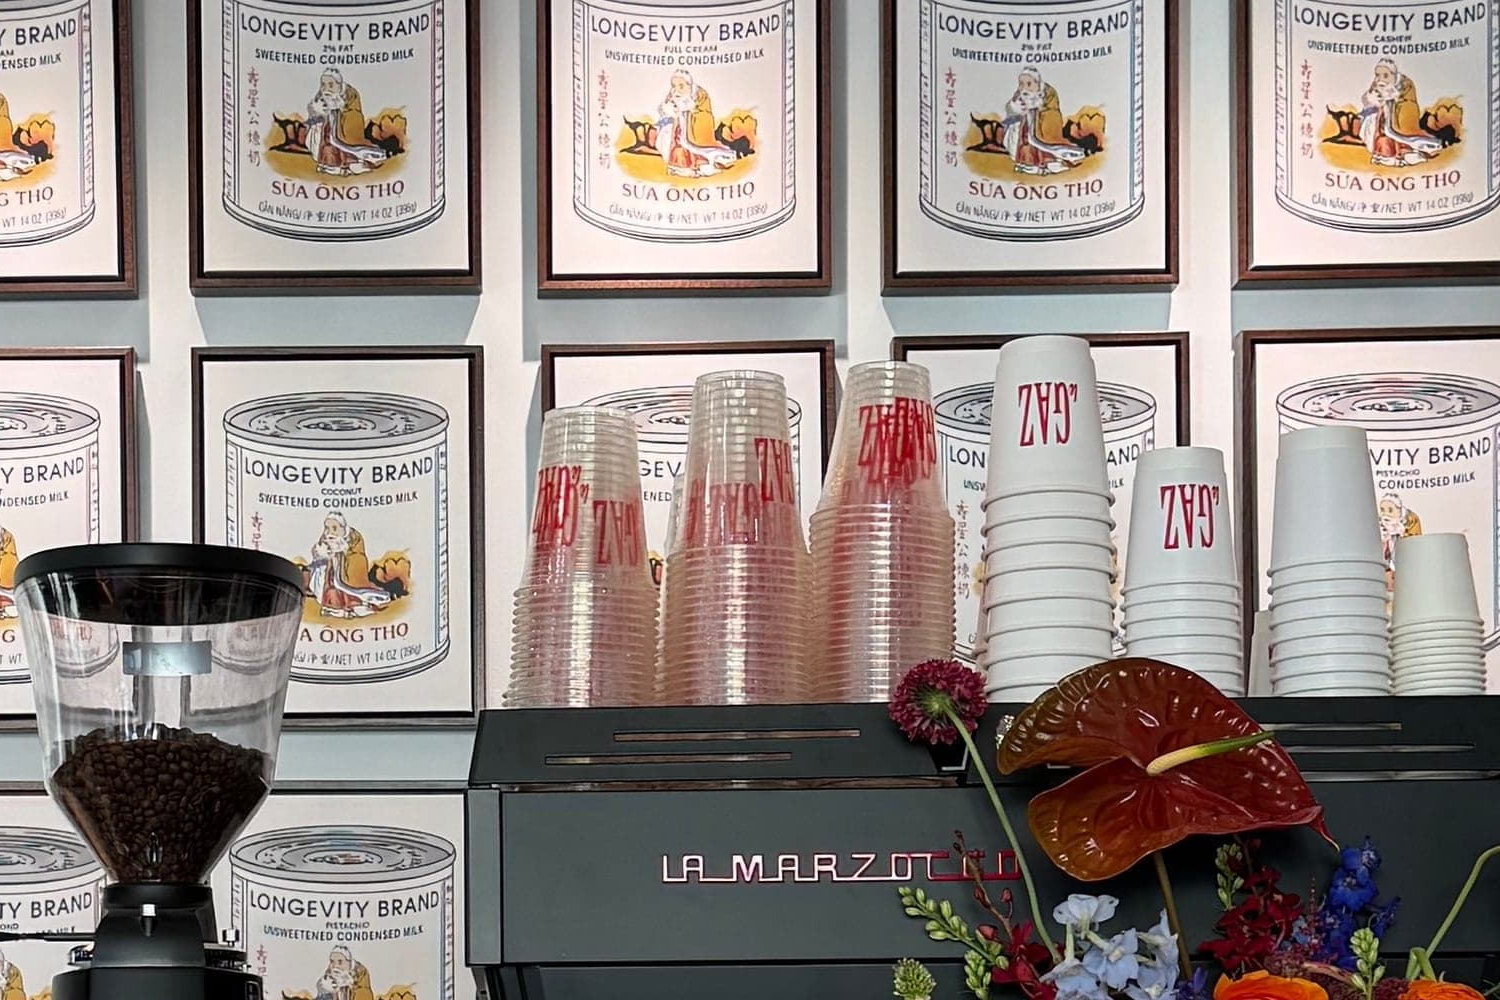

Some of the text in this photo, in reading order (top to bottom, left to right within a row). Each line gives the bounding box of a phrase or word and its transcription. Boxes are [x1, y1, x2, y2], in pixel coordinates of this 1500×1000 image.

[939, 11, 1128, 40] LONGEVITY BRAND
[1295, 2, 1485, 33] LONGEVITY BRAND
[16, 18, 76, 45] BRAND
[241, 13, 429, 41] LONGEVITY BRAND
[592, 14, 780, 42] LONGEVITY BRAND
[1308, 37, 1470, 55] UNSWEETENED CONDENSED MILK
[40, 53, 62, 66] MILK
[255, 48, 414, 65] SWEETENED CONDENSED MILK
[605, 48, 764, 66] UNSWEETENED CONDENSED MILK
[952, 47, 1022, 63] UNSWEETENED
[1026, 50, 1090, 64] CONDENSED
[353, 210, 366, 222] WT
[1051, 210, 1064, 221] WT
[1018, 382, 1071, 446] GAZ
[1429, 437, 1490, 464] BRAND
[23, 456, 84, 482] BRAND
[245, 456, 433, 485] LONGEVITY BRAND
[1376, 469, 1420, 477] PISTACHIO
[1379, 472, 1475, 489] CONDENSED MILK
[49, 491, 68, 503] MILK
[259, 491, 418, 508] SWEETENED CONDENSED MILK
[321, 487, 362, 496] COCONUT
[1160, 484, 1214, 550] GAZ
[9, 653, 22, 664] WT
[357, 653, 370, 664] WT
[662, 854, 703, 882] LA
[31, 892, 92, 919] BRAND
[251, 890, 369, 918] LONGEVITY
[378, 891, 439, 917] BRAND
[263, 924, 424, 941] UNSWEETENED CONDENSED MILK
[325, 921, 370, 929] PISTACHIO
